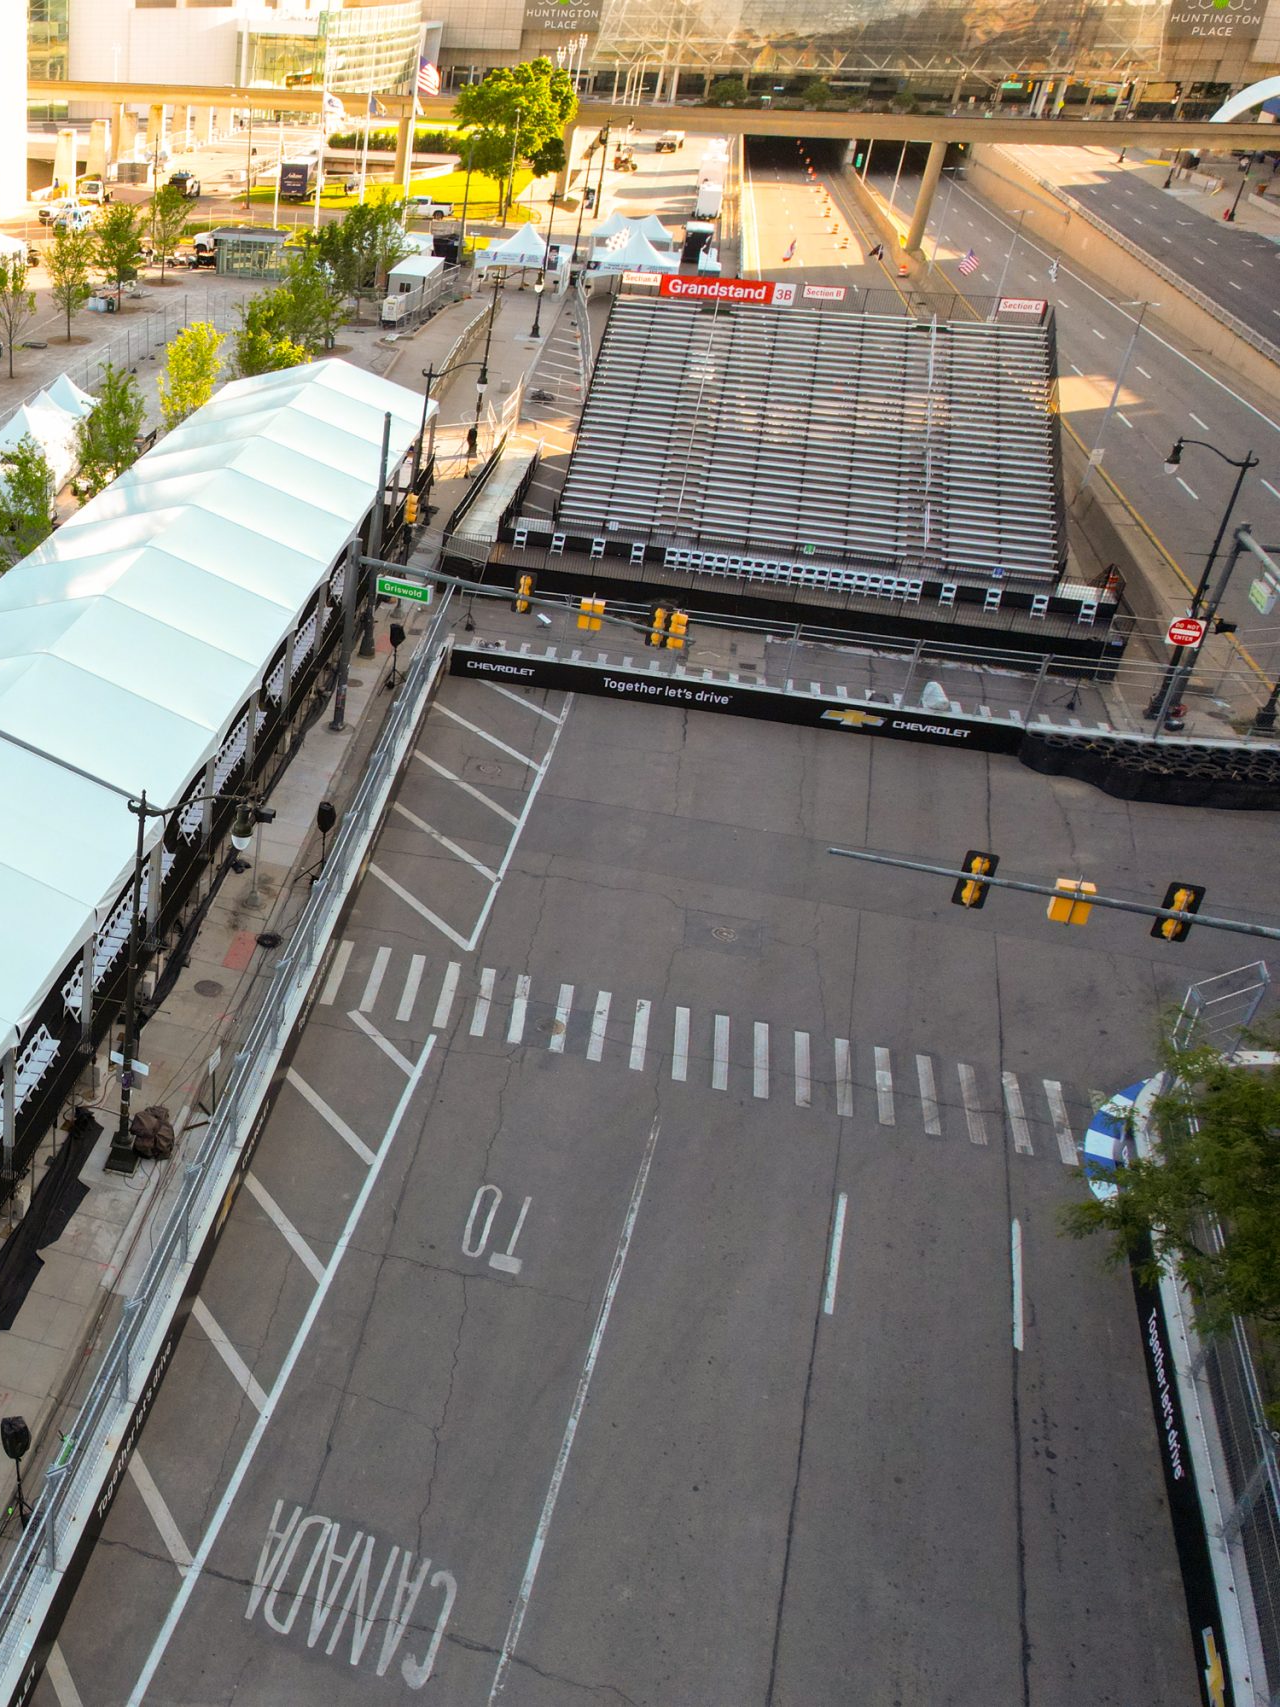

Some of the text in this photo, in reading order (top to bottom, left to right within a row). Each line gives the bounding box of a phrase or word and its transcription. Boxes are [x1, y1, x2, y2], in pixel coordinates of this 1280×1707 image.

[526, 9, 599, 18] HUNTINGTON
[1171, 13, 1261, 25] HUNTINGTON
[544, 20, 578, 29] PLACE
[1191, 26, 1234, 36] PLACE
[668, 279, 793, 301] Grandstand 3B
[806, 288, 842, 298] Section B
[1002, 301, 1041, 311] Section C
[384, 583, 422, 598] Griswold
[1173, 634, 1194, 642] ENTER
[467, 660, 535, 677] CHEVROLET
[603, 677, 730, 705] Together let's drive
[892, 720, 971, 739] CHEVROLET
[462, 1184, 533, 1275] TO
[1147, 1307, 1184, 1480] Together let's drive
[97, 1430, 136, 1518] Together
[244, 1499, 457, 1689] CANADA
